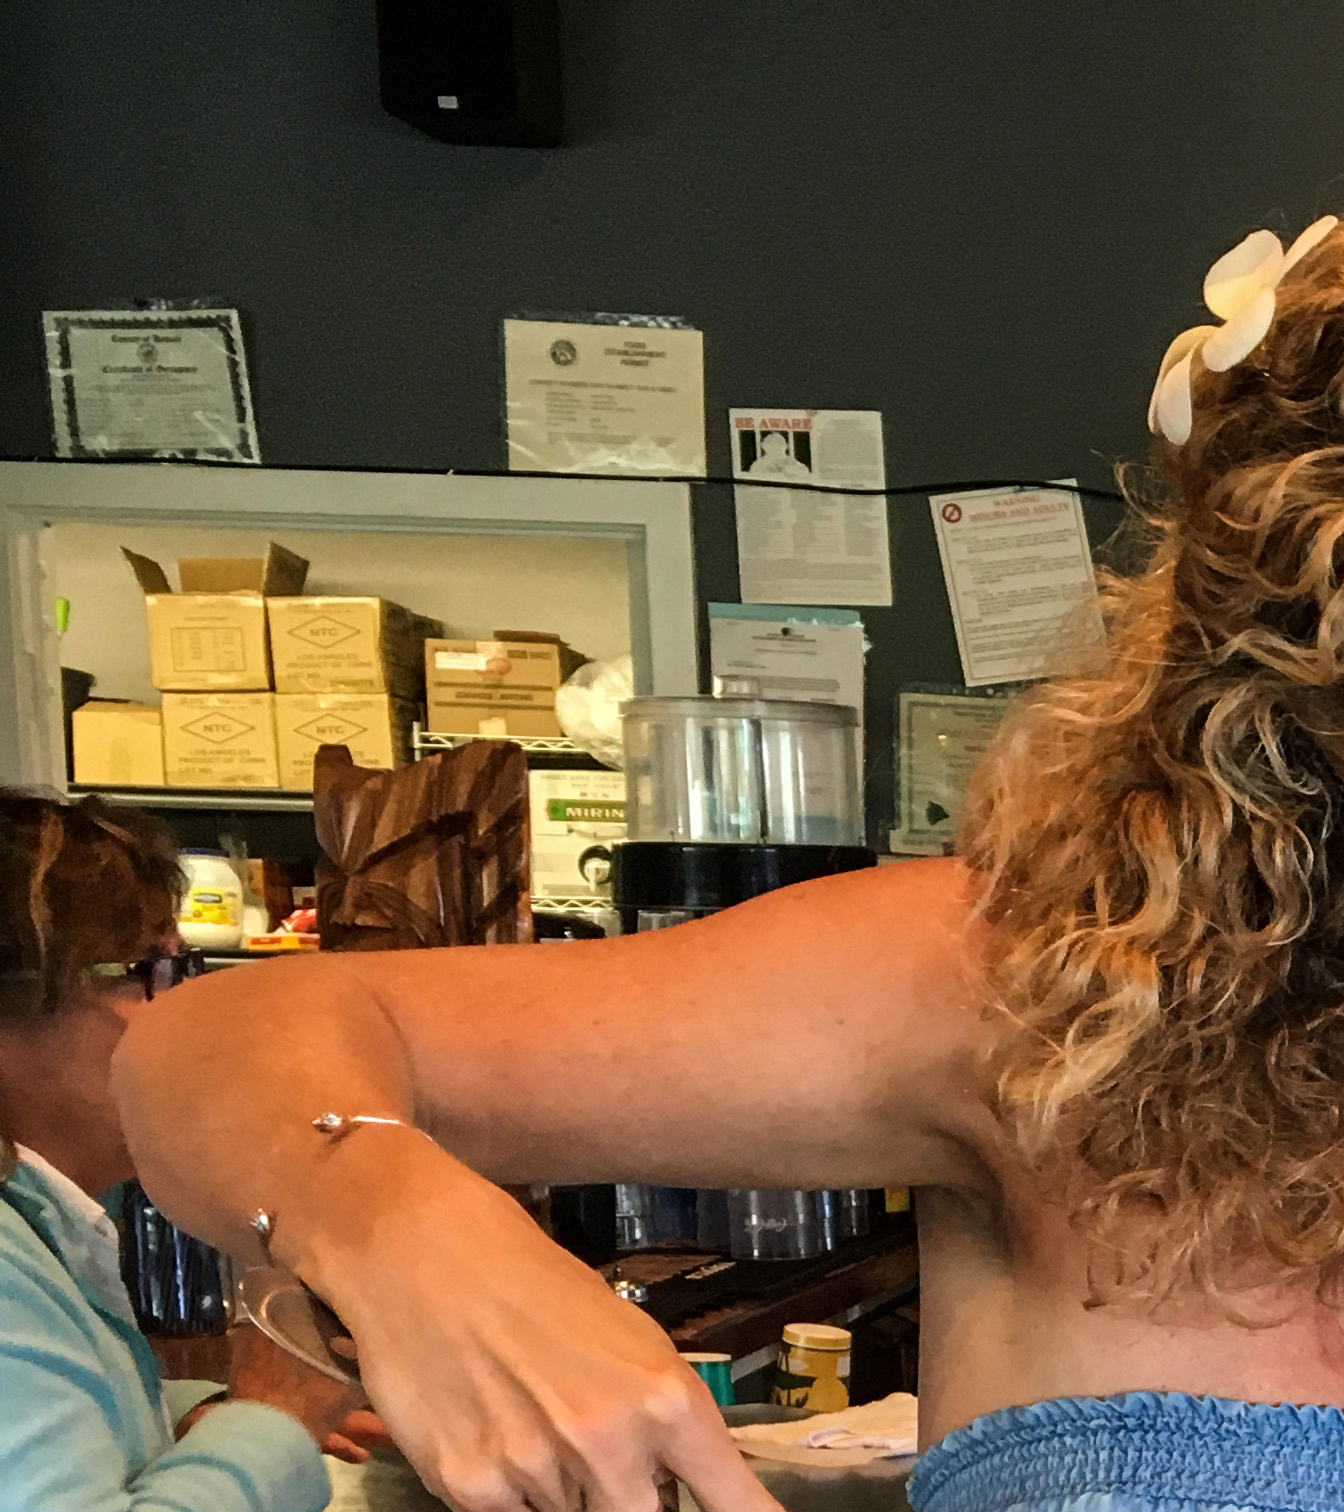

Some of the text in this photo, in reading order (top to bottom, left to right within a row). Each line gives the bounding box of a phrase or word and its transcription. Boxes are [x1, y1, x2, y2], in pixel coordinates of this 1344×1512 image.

[735, 417, 813, 430] BE AWARE
[310, 627, 338, 638] NTC
[203, 723, 231, 733] NTC
[316, 725, 345, 735] NTC
[566, 808, 624, 818] MIRIN
